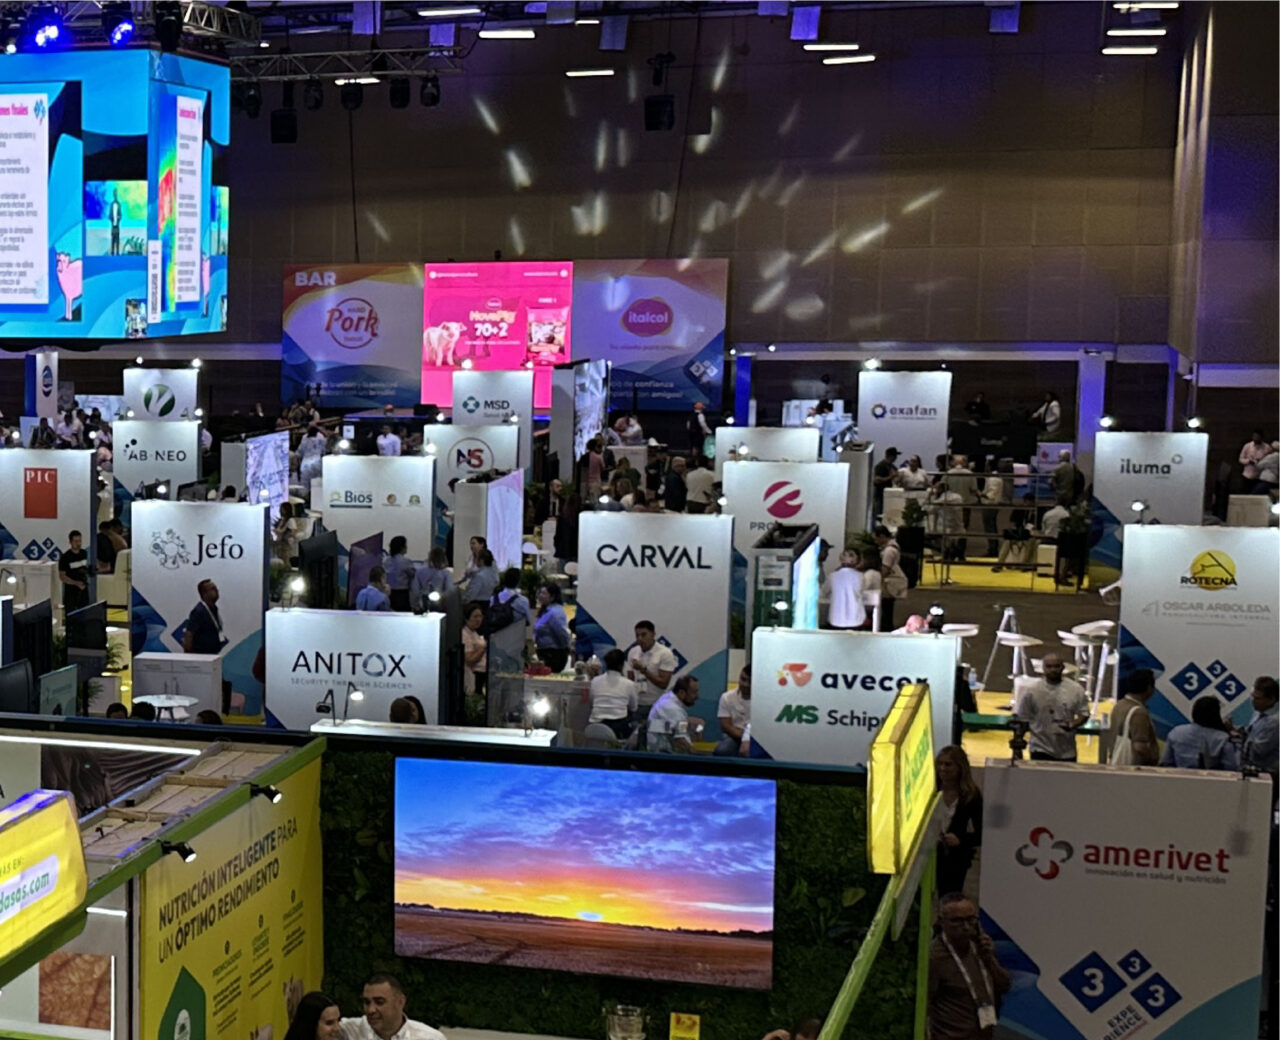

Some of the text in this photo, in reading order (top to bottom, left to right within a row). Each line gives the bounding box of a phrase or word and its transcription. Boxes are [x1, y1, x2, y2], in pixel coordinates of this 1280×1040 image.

[295, 272, 336, 286] BAR
[325, 308, 378, 337] Pork
[628, 311, 669, 323] italcol
[474, 323, 509, 337] 70+2
[483, 400, 510, 409] MSD
[889, 405, 937, 416] exafan
[155, 451, 186, 462] NEO
[1120, 457, 1171, 475] iluma
[26, 470, 56, 483] PIC
[344, 491, 373, 503] Bios
[193, 534, 244, 565] Jefo
[597, 544, 712, 569] CARVAL
[1180, 576, 1237, 586] ROTECNA
[1162, 601, 1271, 613] OSCAR ARBOLEDA
[292, 650, 407, 678] ANITOX
[291, 677, 329, 686] SECURITY
[332, 679, 371, 687] THRUGH
[775, 704, 886, 732] MS Schip
[1083, 844, 1231, 873] amerivet
[158, 868, 215, 931] NUTRICIÓN
[216, 832, 276, 891] INTELIGENTE
[276, 817, 298, 848] PARA
[1085, 867, 1135, 878] innovación
[1149, 870, 1175, 881] salud
[1184, 873, 1227, 884] nutrición
[158, 933, 174, 963] UN
[175, 905, 217, 951] ÓPTIMO
[218, 858, 280, 918] RENDIMIENTO
[1081, 957, 1166, 1008] 3 3 3
[1107, 1004, 1137, 1029] EXPE
